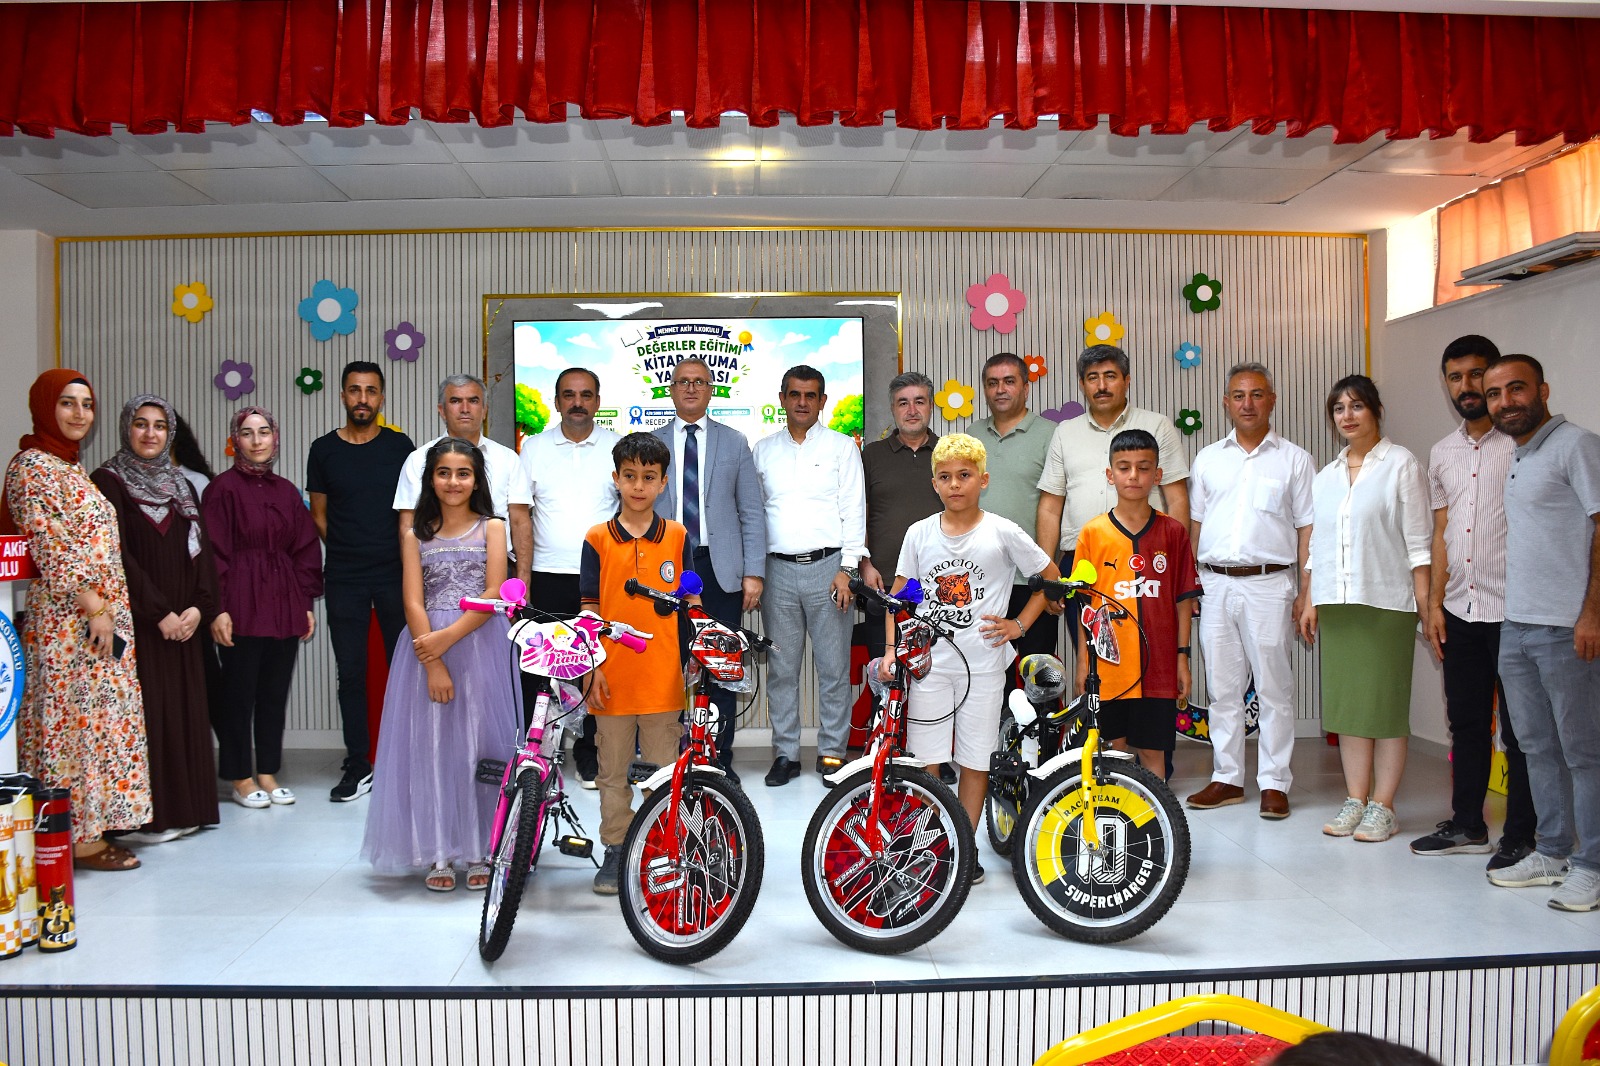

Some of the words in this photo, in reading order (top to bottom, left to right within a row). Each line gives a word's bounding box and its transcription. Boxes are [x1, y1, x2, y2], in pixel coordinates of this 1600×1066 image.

[657, 326, 679, 334] MEHMET
[694, 325, 720, 333] İLKOKULU
[637, 340, 696, 357] DEĞERLER
[700, 339, 742, 355] EĞİTİMİ
[645, 418, 667, 426] RECEP
[3, 540, 28, 558] AKİF
[924, 558, 986, 584] FEROCIOUS
[973, 587, 985, 601] 13
[540, 651, 588, 668] Diana
[1064, 859, 1154, 909] SUPERCHARGED
